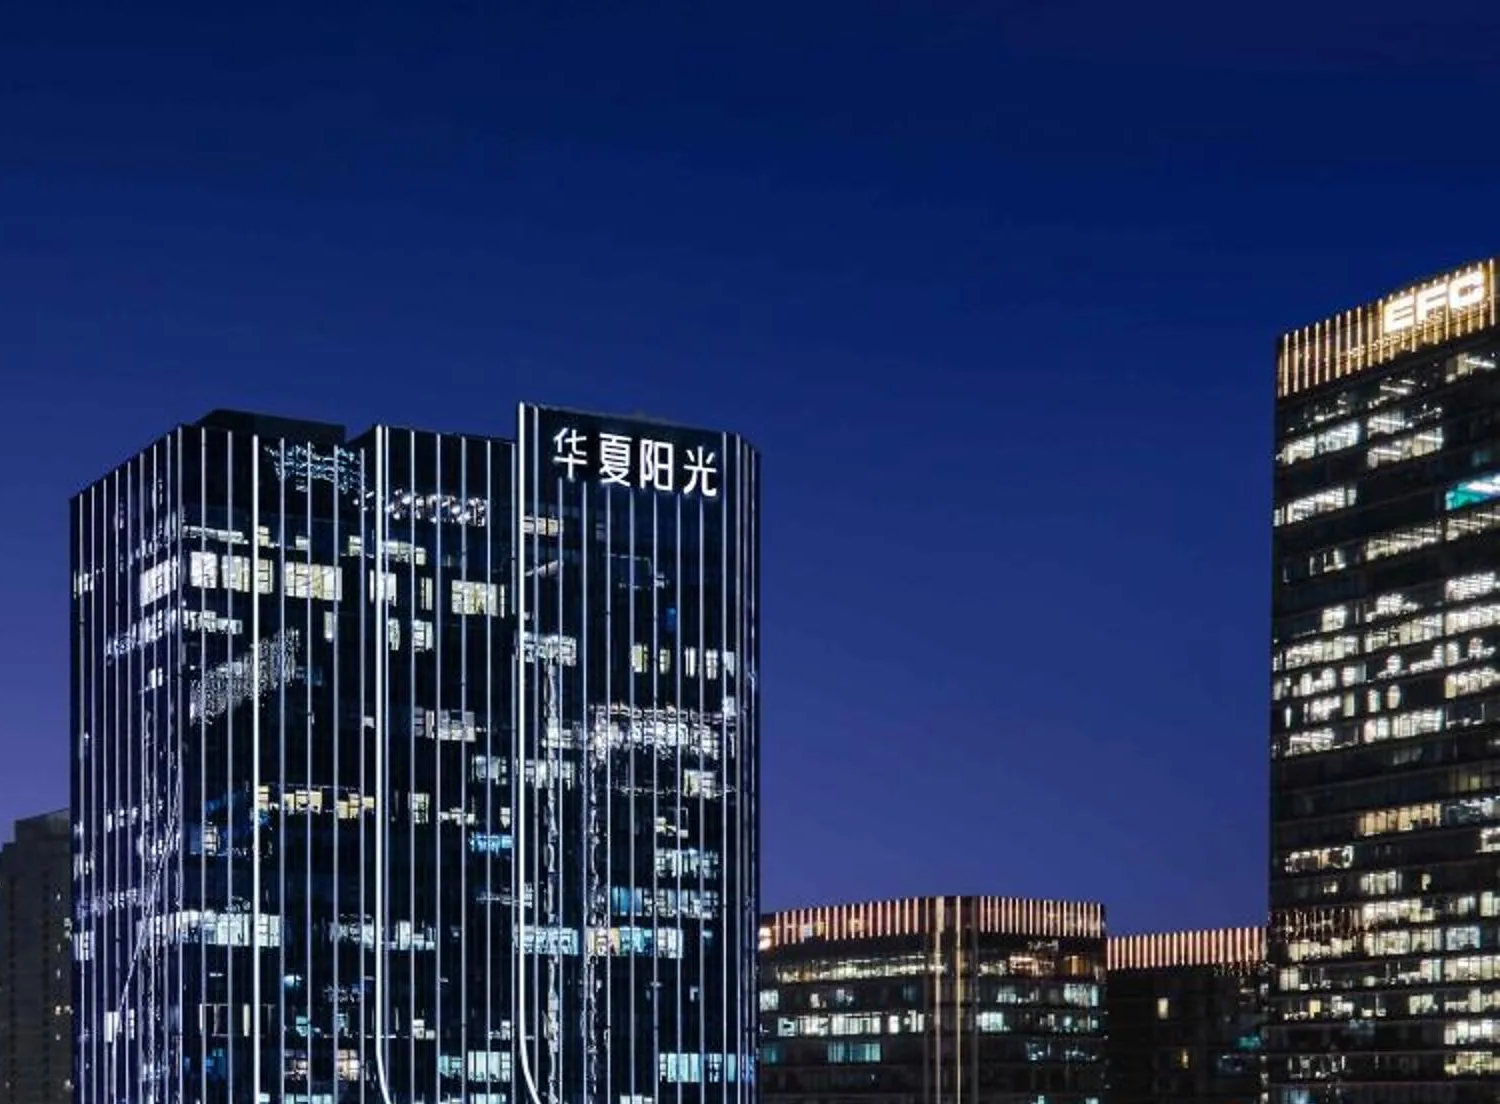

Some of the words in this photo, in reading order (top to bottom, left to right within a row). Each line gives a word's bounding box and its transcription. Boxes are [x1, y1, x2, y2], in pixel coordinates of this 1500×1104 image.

[1384, 270, 1485, 332] EFC
[553, 427, 717, 497] 华夏阳光
